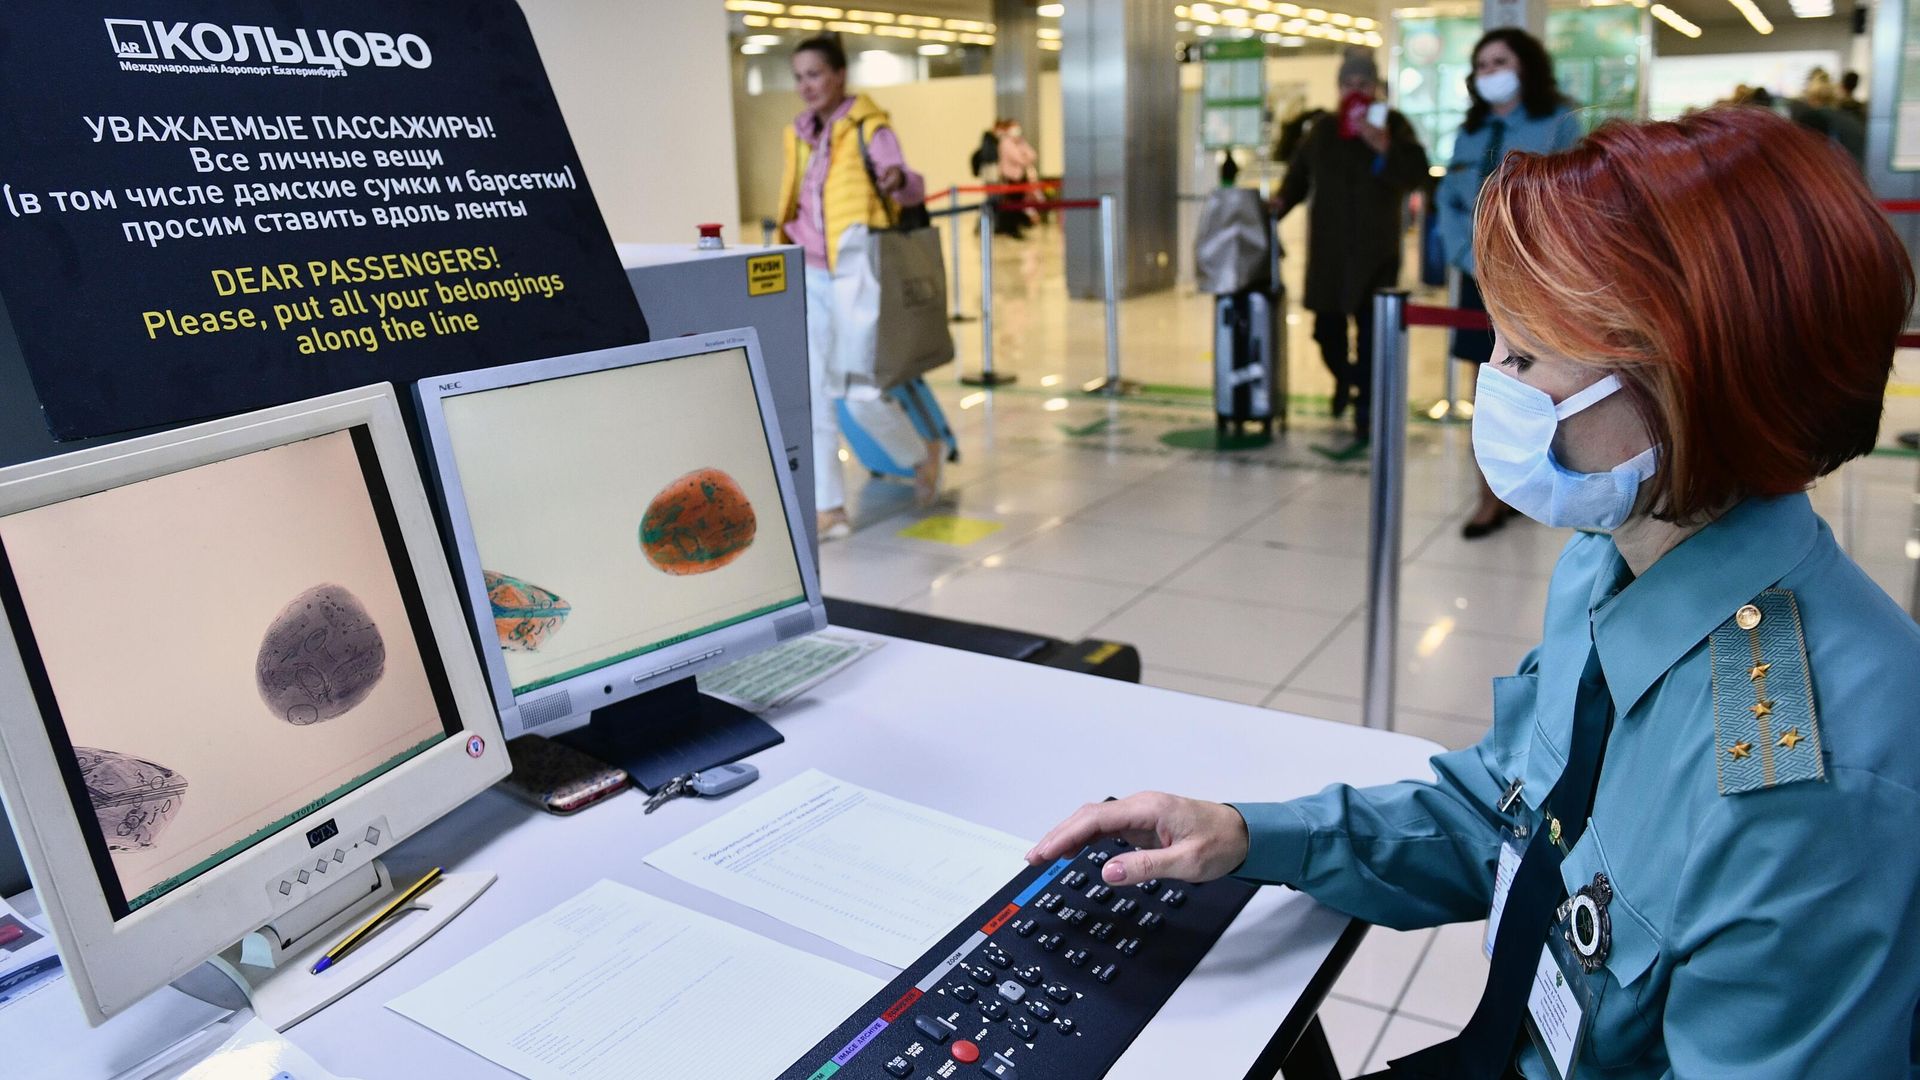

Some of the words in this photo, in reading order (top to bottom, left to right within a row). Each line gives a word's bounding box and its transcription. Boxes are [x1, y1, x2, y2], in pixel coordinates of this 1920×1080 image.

[119, 41, 141, 54] AR
[152, 21, 432, 70] КОЛЬЦОВО
[119, 61, 219, 74] Международный
[220, 65, 272, 76] Аэропорт
[273, 65, 348, 78] Екатеринбурга
[83, 116, 308, 142] УВАЖАЕМЫЕ
[312, 116, 496, 139] ПАССАЖИРЫ!
[189, 147, 250, 172] Все
[259, 151, 367, 170] личные
[373, 149, 443, 169] вещи
[3, 184, 41, 217] (в
[49, 190, 117, 211] том
[125, 185, 224, 207] числе
[234, 180, 357, 207] дамские
[364, 177, 441, 201] сумки
[445, 176, 463, 192] и
[466, 165, 576, 196] барсетки)
[122, 216, 246, 247] просим
[254, 209, 366, 232] ставить
[372, 205, 450, 228] вдоль
[455, 200, 527, 220] ленты
[212, 264, 304, 296] DEAR
[308, 246, 504, 290] PASSENGERS!
[752, 260, 781, 273] PUSH
[143, 309, 267, 339] Please,
[274, 297, 324, 330] put
[330, 290, 368, 316] all
[371, 289, 429, 317] your
[435, 273, 564, 303] belongings
[297, 327, 378, 354] along
[381, 317, 426, 341] the
[430, 311, 479, 334] line
[438, 381, 463, 391] NEC
[290, 797, 328, 820] STOPPED
[310, 822, 336, 844] CTX
[946, 952, 962, 966] ZOOM
[947, 1012, 960, 1022] FWD
[838, 1043, 858, 1061] IMAGE
[859, 1022, 882, 1045] ARCHIVE
[975, 1028, 988, 1041] STOP
[905, 1041, 921, 1056] LOOK
[911, 1046, 924, 1058] FWD
[1003, 1047, 1015, 1058] REV
[936, 1059, 954, 1075] IMAGE
[942, 1064, 957, 1079] REVU
